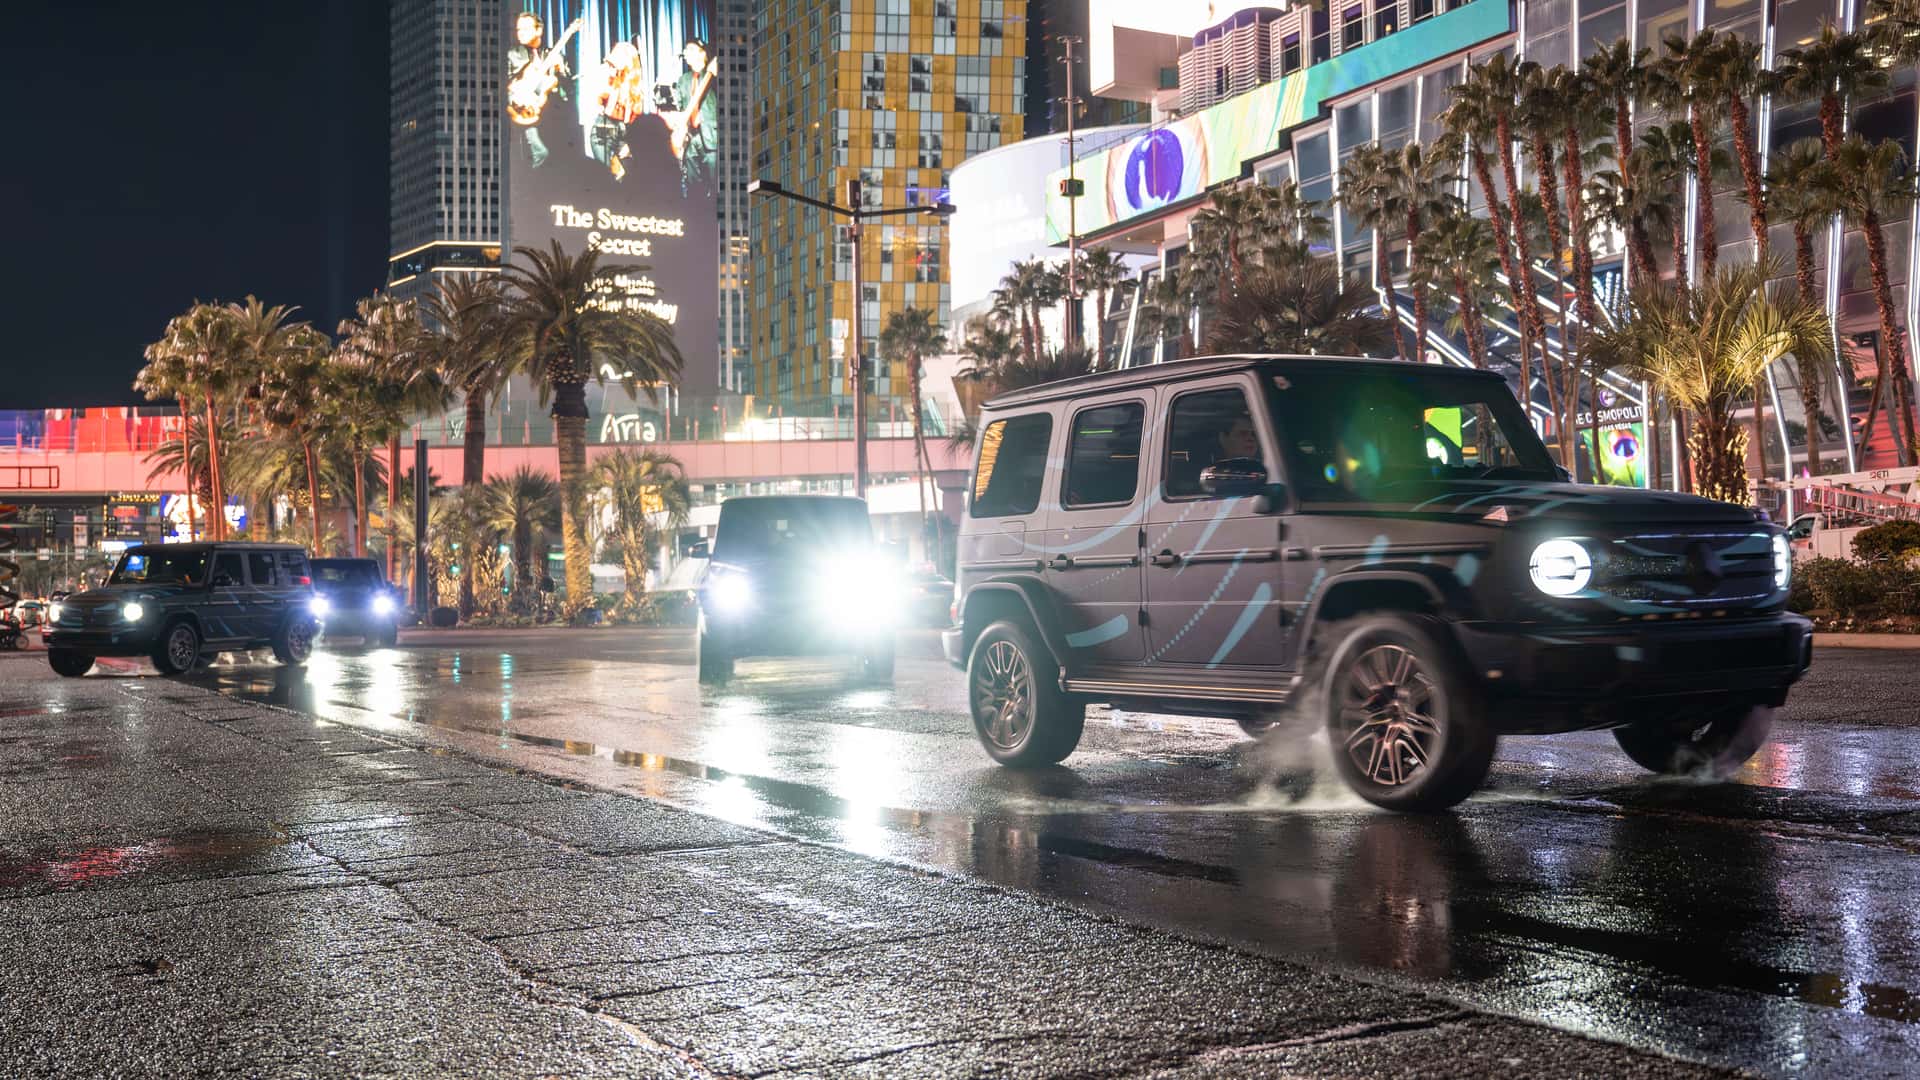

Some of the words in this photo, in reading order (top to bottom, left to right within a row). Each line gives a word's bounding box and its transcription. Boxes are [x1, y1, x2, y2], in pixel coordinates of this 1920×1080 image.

[550, 205, 593, 228] The
[597, 208, 684, 236] Sweetest
[587, 231, 651, 256] Secret
[600, 414, 655, 443] Aria
